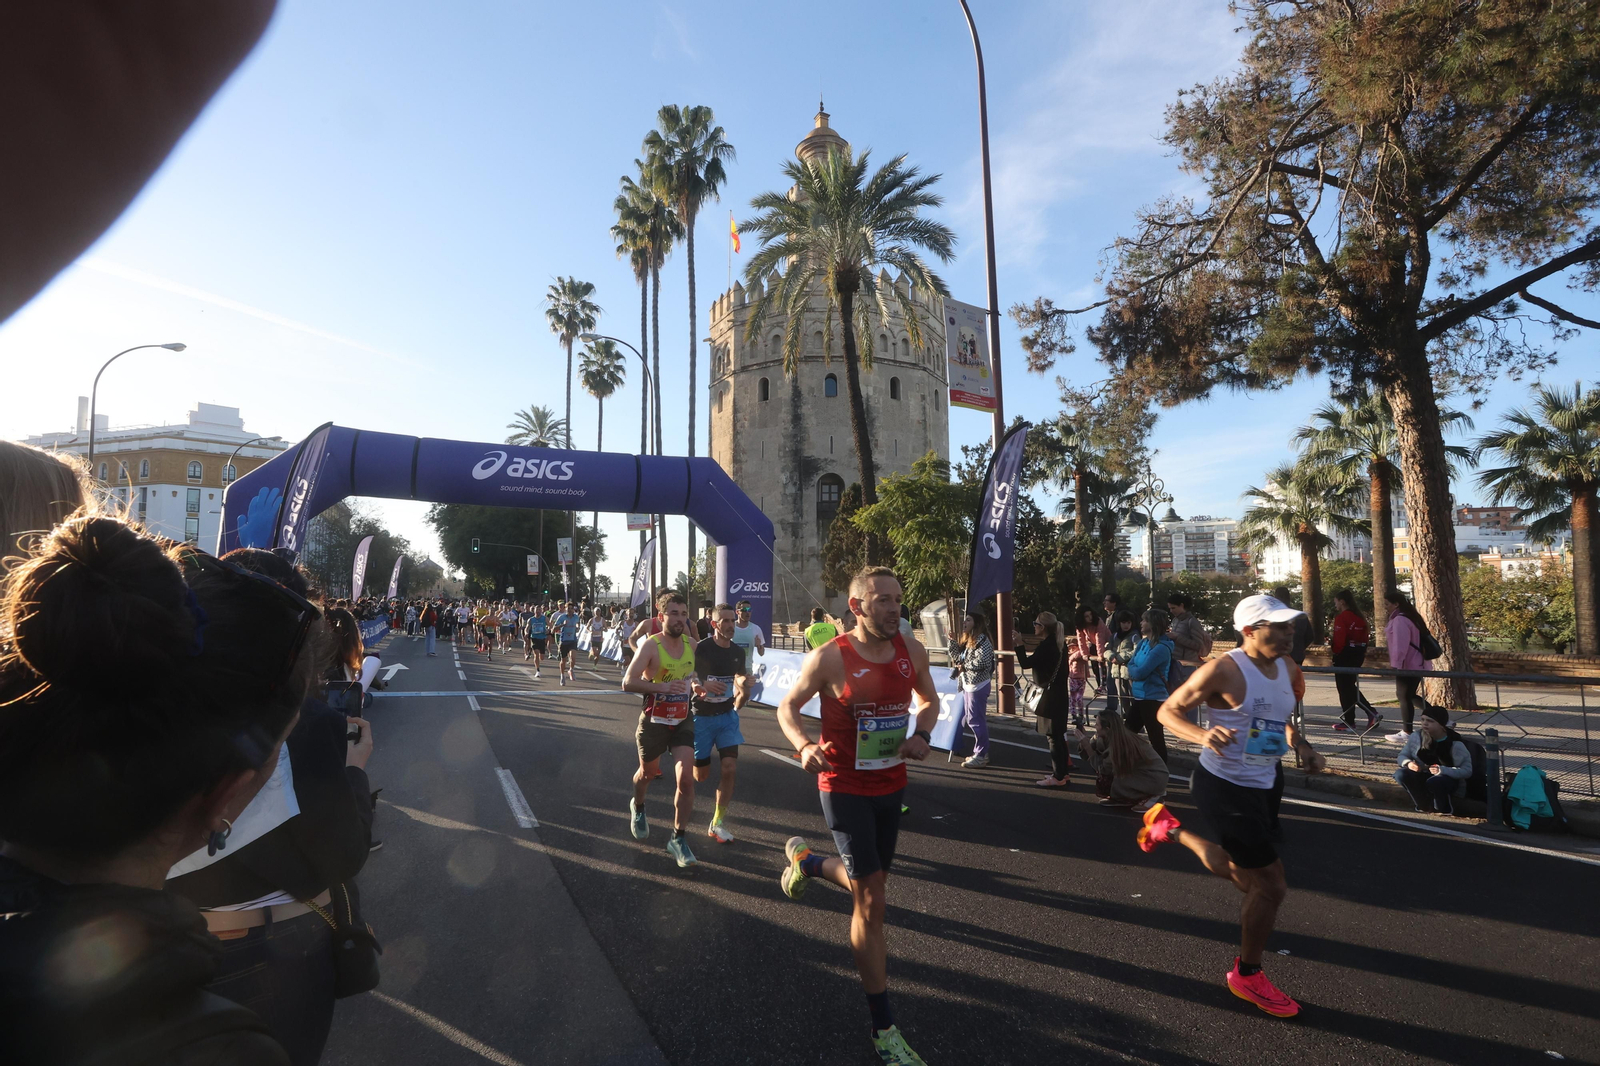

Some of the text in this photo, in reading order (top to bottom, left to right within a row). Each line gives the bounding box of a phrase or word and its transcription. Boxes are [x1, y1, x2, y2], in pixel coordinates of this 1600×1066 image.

[506, 457, 575, 481] asics
[289, 475, 309, 525] asics
[524, 486, 543, 494] mind,
[545, 488, 567, 496] sound
[568, 488, 587, 497] body
[990, 480, 1010, 533] asics
[743, 581, 770, 592] asics
